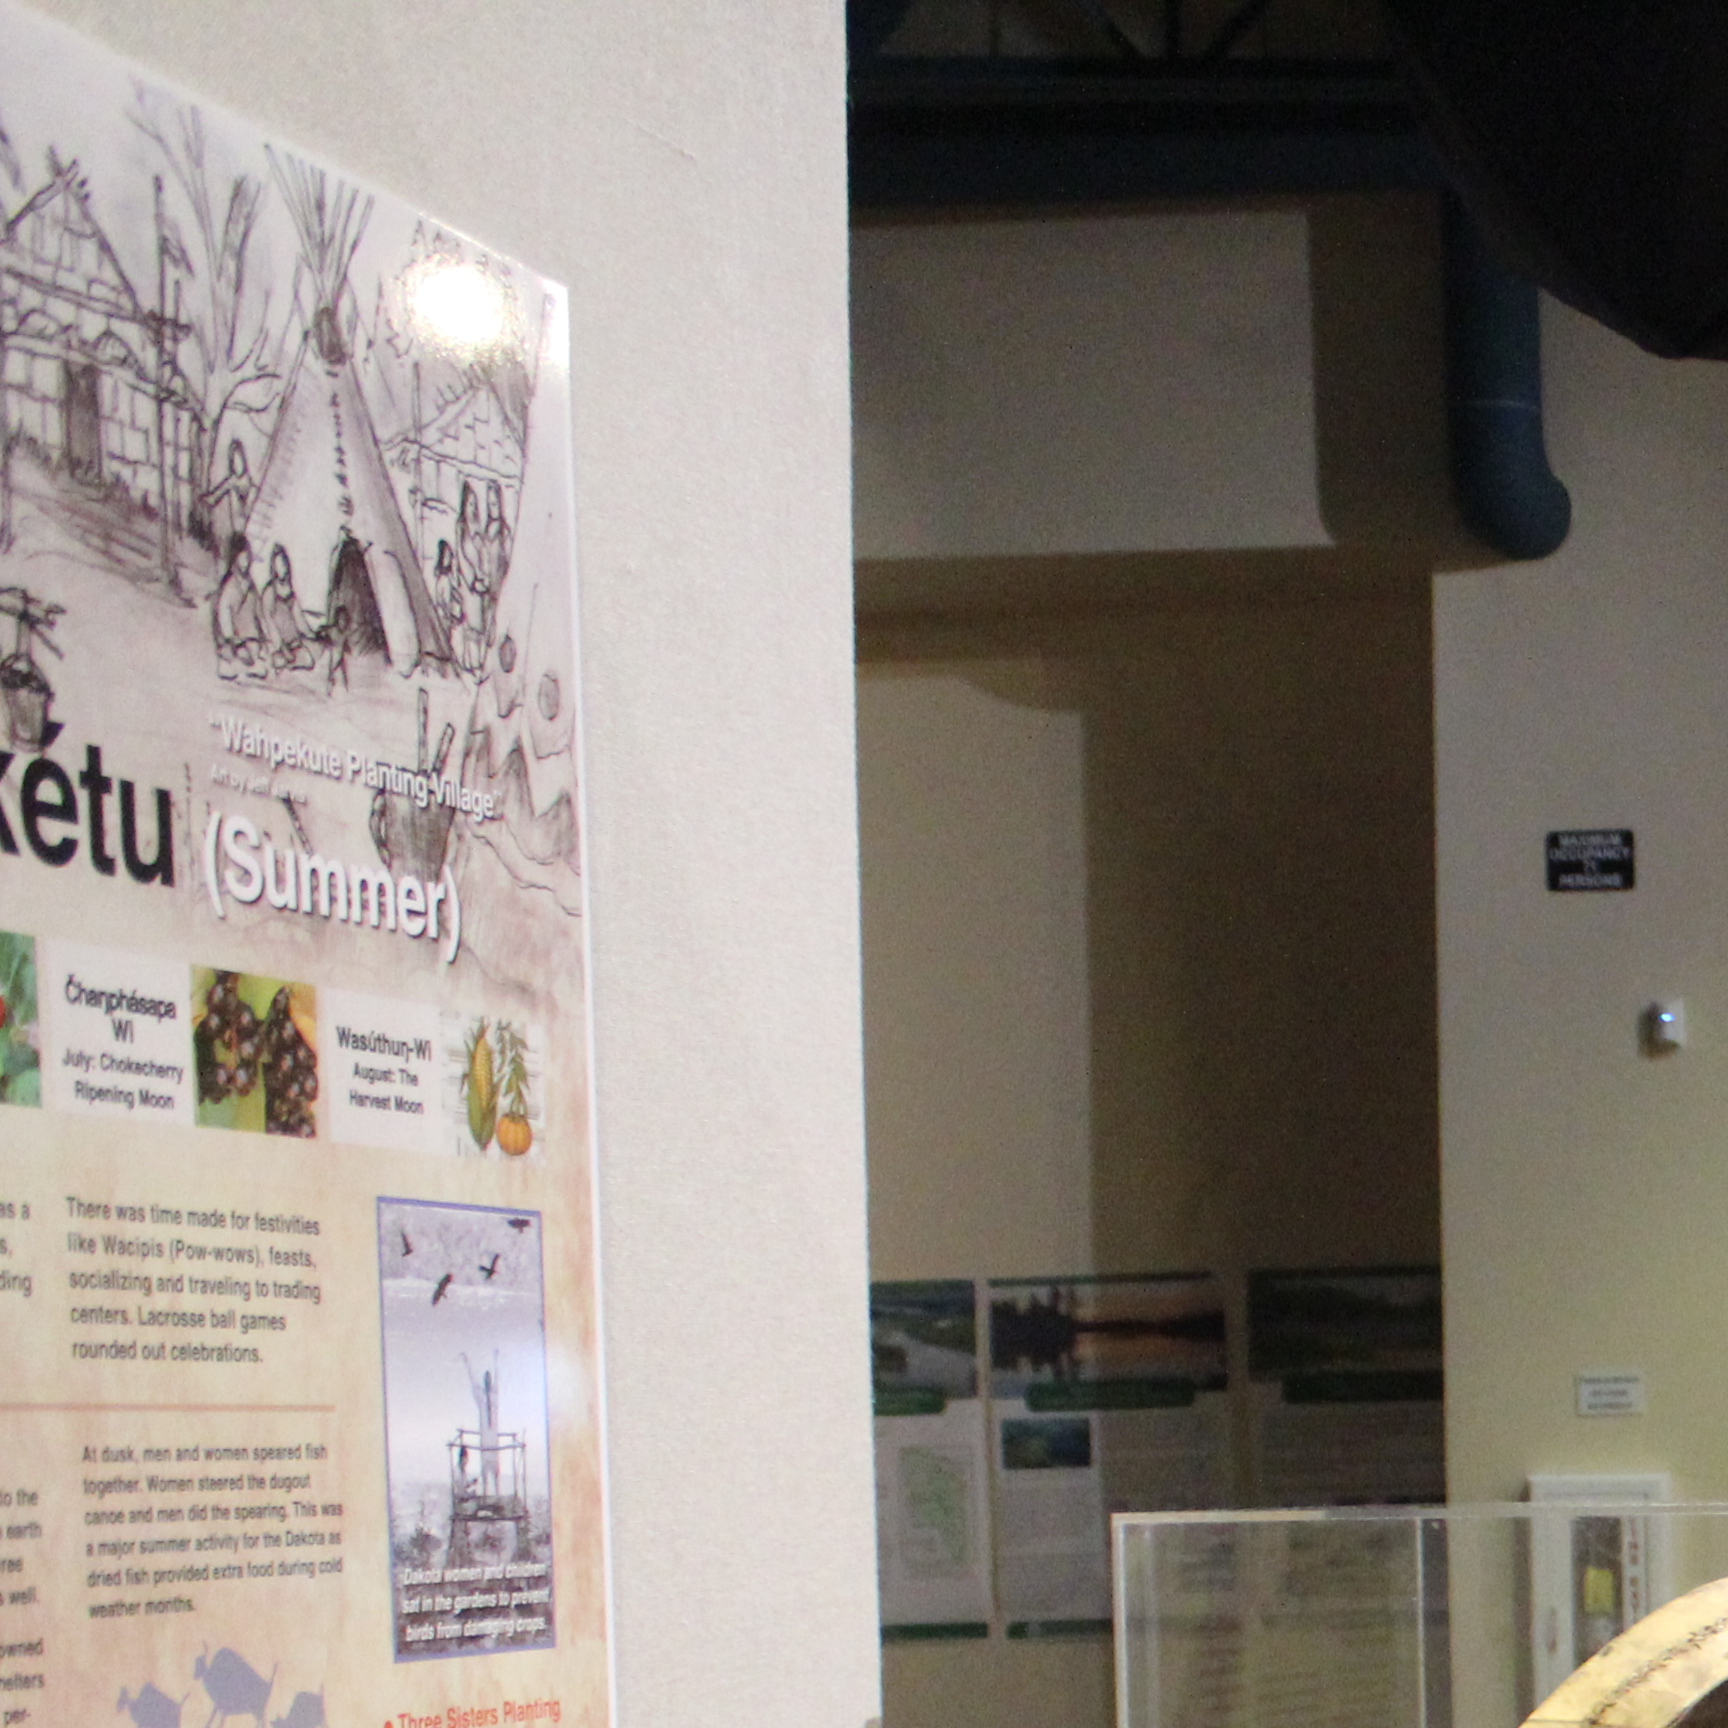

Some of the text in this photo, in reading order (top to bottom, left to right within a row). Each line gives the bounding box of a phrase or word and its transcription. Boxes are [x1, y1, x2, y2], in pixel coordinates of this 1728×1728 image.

[347, 750, 428, 808] Planting
[205, 810, 461, 964] (Summer)
[63, 1048, 183, 1084] July: Chokecherry
[353, 1062, 419, 1087] August: The
[75, 1080, 174, 1110] Ripening Moon
[349, 1089, 424, 1114] Harvest Moon
[68, 1196, 320, 1236] There was time made for festivities
[68, 1233, 96, 1254] like
[101, 1234, 164, 1261] Wacipis
[269, 1246, 316, 1269] feasts,
[69, 1269, 322, 1305] socializing and traveling to trading
[70, 1306, 286, 1334] centers. Lacrosse ball games
[72, 1340, 262, 1363] rounded out celebrations.
[82, 1446, 96, 1462] At
[143, 1448, 171, 1462] men
[175, 1445, 200, 1462] and
[204, 1448, 249, 1461] women
[252, 1445, 301, 1464] speared
[305, 1443, 327, 1460] fish
[146, 1475, 194, 1492] Women
[198, 1474, 244, 1491] steered
[247, 1474, 266, 1490] the
[269, 1474, 310, 1494] dugout
[85, 1510, 125, 1525] canoe
[129, 1506, 153, 1524] and
[157, 1508, 184, 1522] men
[188, 1504, 208, 1521] did
[210, 1504, 230, 1520] the
[292, 1501, 318, 1517] This
[321, 1503, 344, 1516] was
[98, 1540, 135, 1560] major
[139, 1538, 191, 1555] summer
[195, 1533, 239, 1553] activity
[242, 1532, 259, 1549] for
[262, 1532, 282, 1548] the
[285, 1530, 326, 1547] Dakota
[328, 1532, 342, 1545] as
[87, 1557, 343, 1588] dried fish provided extra food during cold
[89, 1600, 140, 1618] weather
[503, 1699, 561, 1724] Planting
